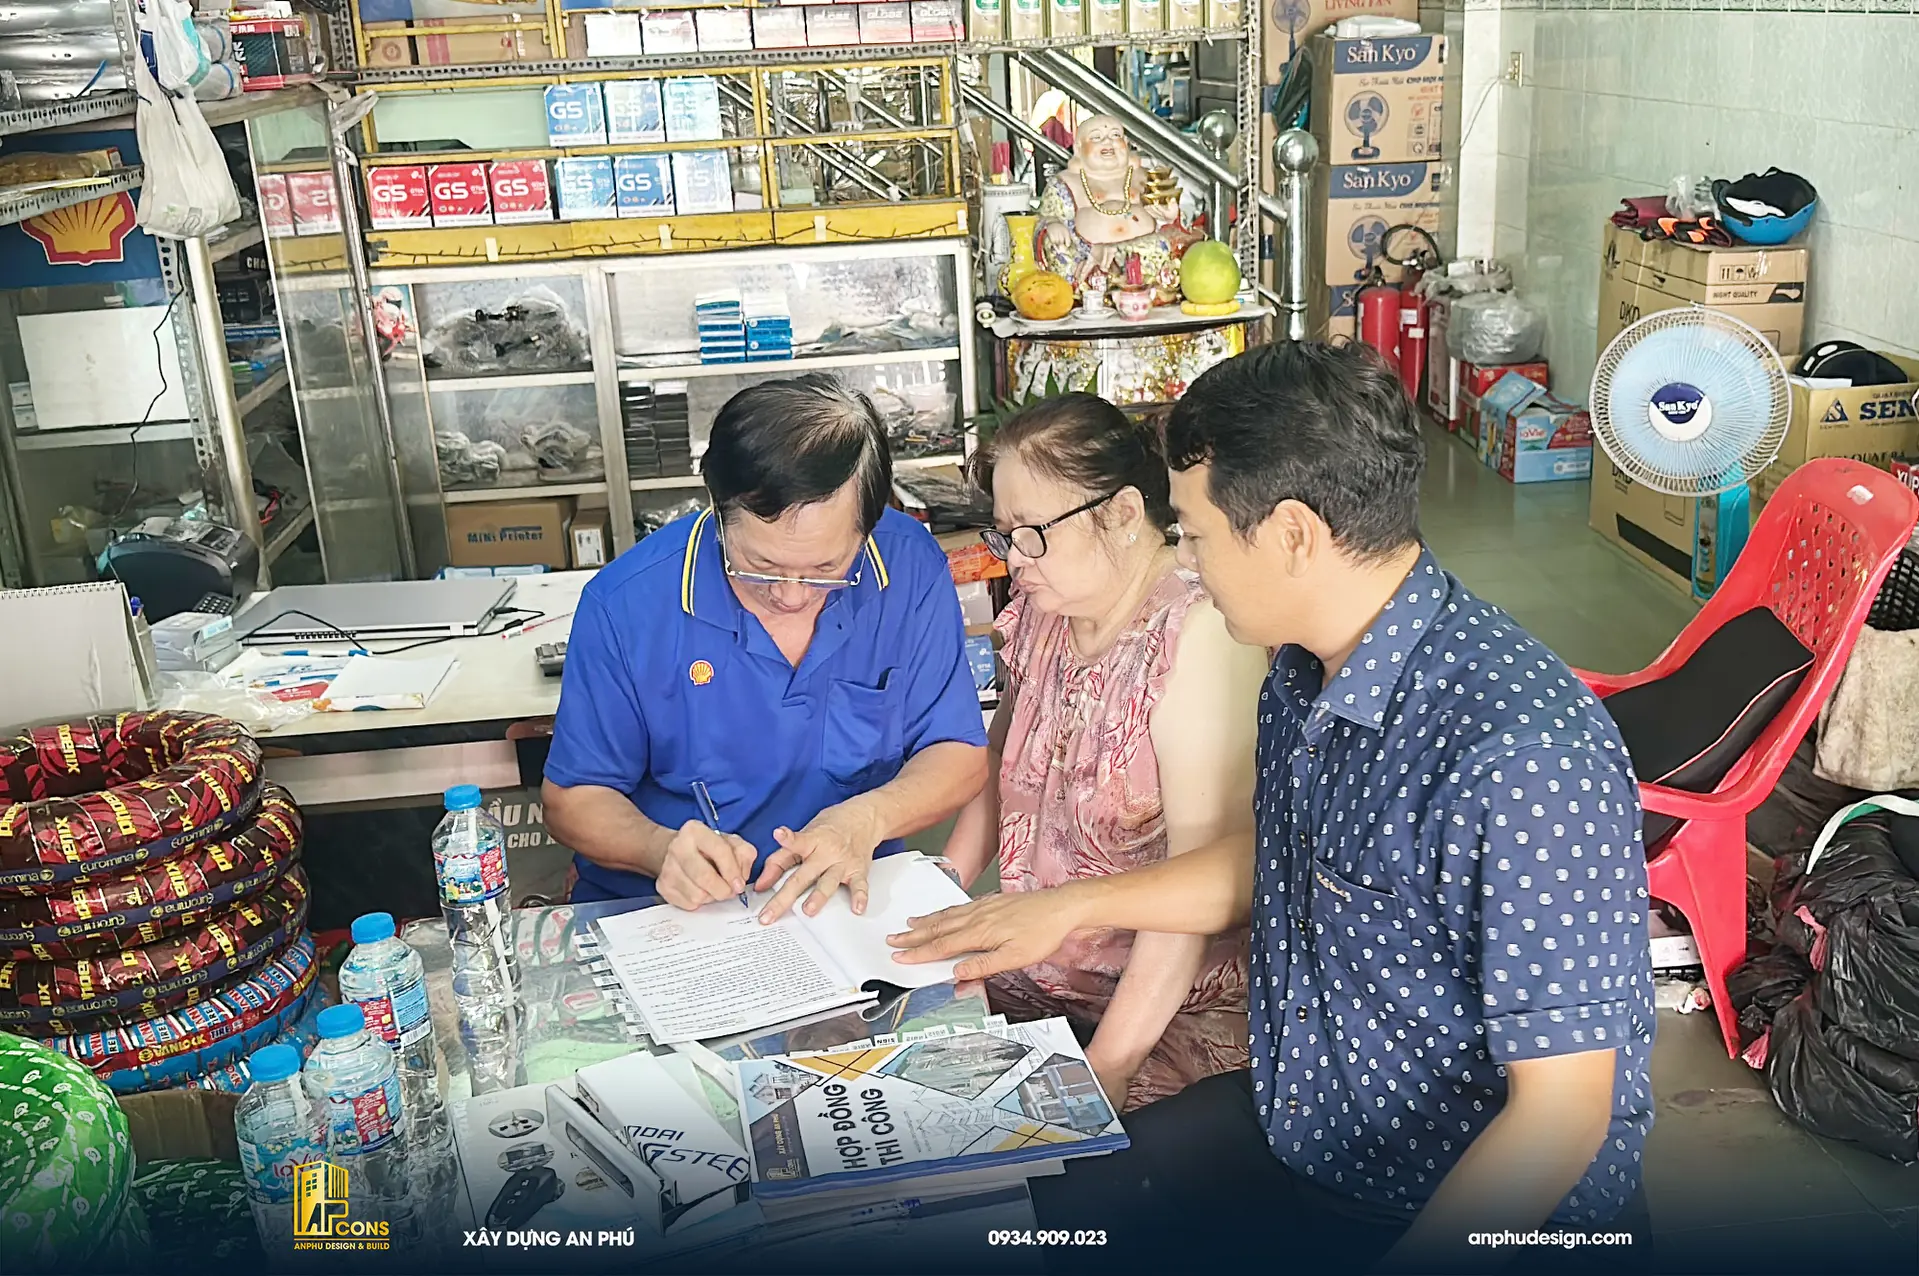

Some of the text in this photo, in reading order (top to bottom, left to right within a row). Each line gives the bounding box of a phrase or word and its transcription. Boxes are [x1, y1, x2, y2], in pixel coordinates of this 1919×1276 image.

[1347, 44, 1416, 65] San Kyo
[550, 102, 583, 119] GS
[434, 182, 469, 200] GS
[495, 178, 529, 197] GS
[618, 173, 652, 191] GS
[1343, 171, 1411, 192] San Kyo
[372, 184, 408, 202] GS
[1658, 400, 1699, 412] San Kyo
[500, 530, 543, 541] Printer
[488, 797, 522, 826] ẦU
[507, 832, 542, 849] CHO
[80, 853, 134, 873] Euromina
[154, 1024, 232, 1058] VANLOCK TIRE
[818, 1083, 861, 1133] ĐỒNG
[860, 1087, 904, 1166] THI CÔNG
[837, 1135, 869, 1171] HỢP
